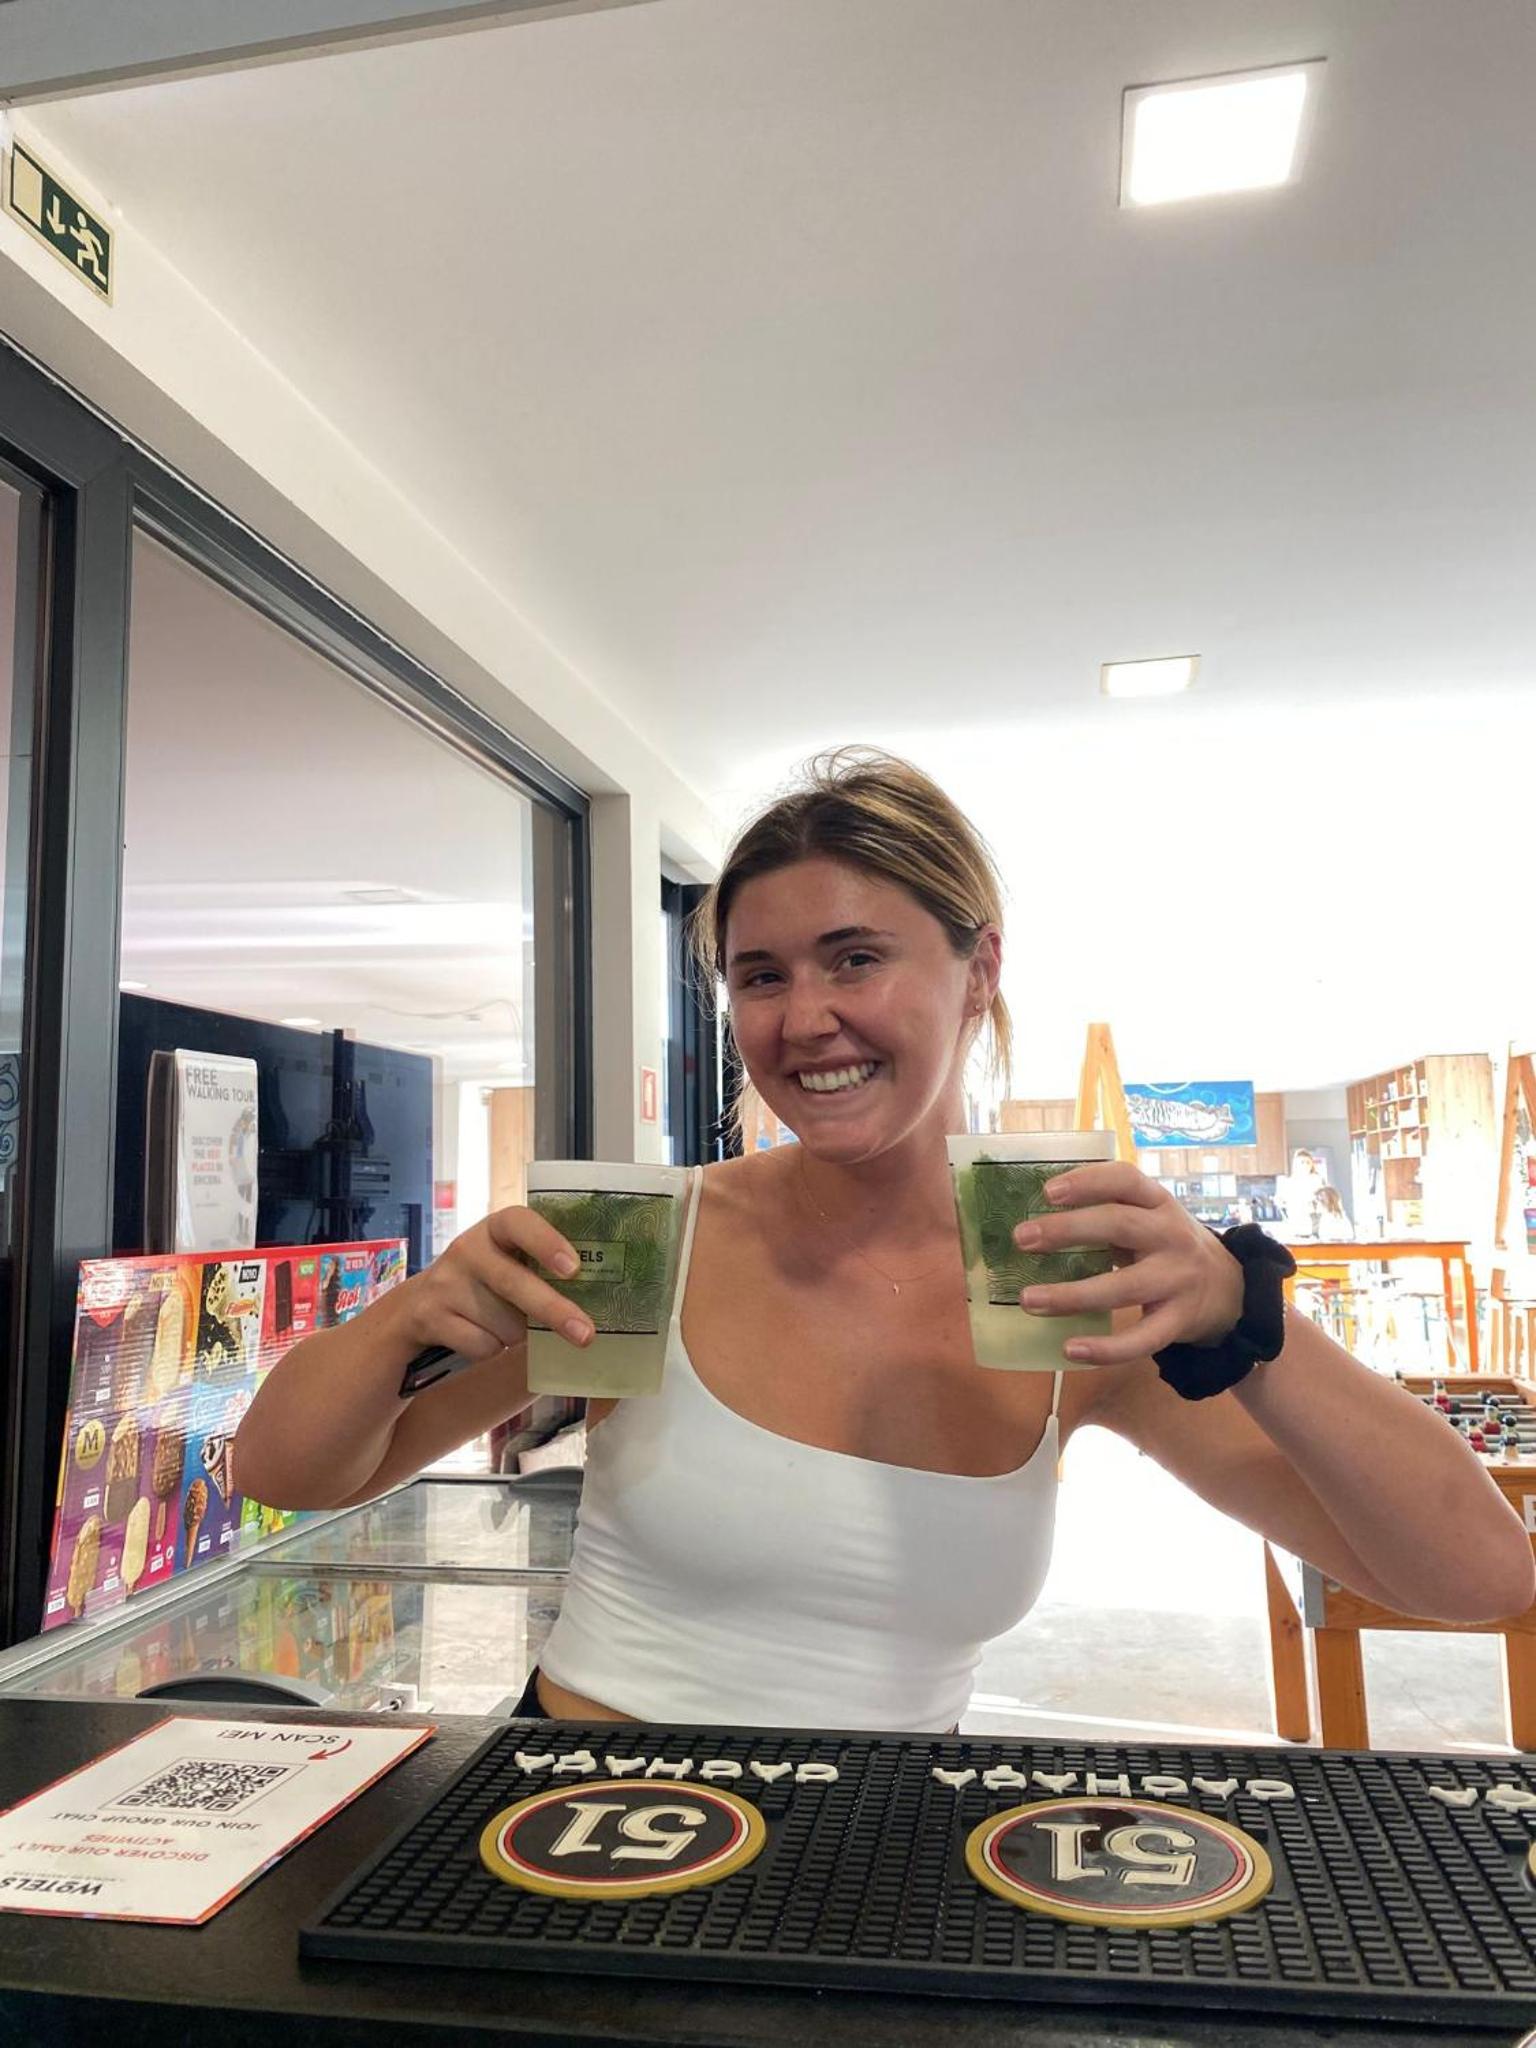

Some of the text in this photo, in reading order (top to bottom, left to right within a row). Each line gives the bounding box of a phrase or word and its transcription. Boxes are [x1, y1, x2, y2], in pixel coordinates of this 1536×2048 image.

[185, 1066, 218, 1086] FREE
[187, 1083, 230, 1101] WALKING
[82, 1428, 99, 1454] M
[216, 1728, 340, 1745] SCAN ME!
[514, 1750, 840, 1784] CACHAÇA
[932, 1764, 1296, 1801] CACHAÇA
[51, 1811, 262, 1831] JOIN OUR GROUP CHAT
[548, 1801, 707, 1862] 51
[81, 1833, 175, 1845] ACTIVITIES
[14, 1841, 209, 1862] DISCOVER OUR DAILY
[1033, 1822, 1198, 1886] 51
